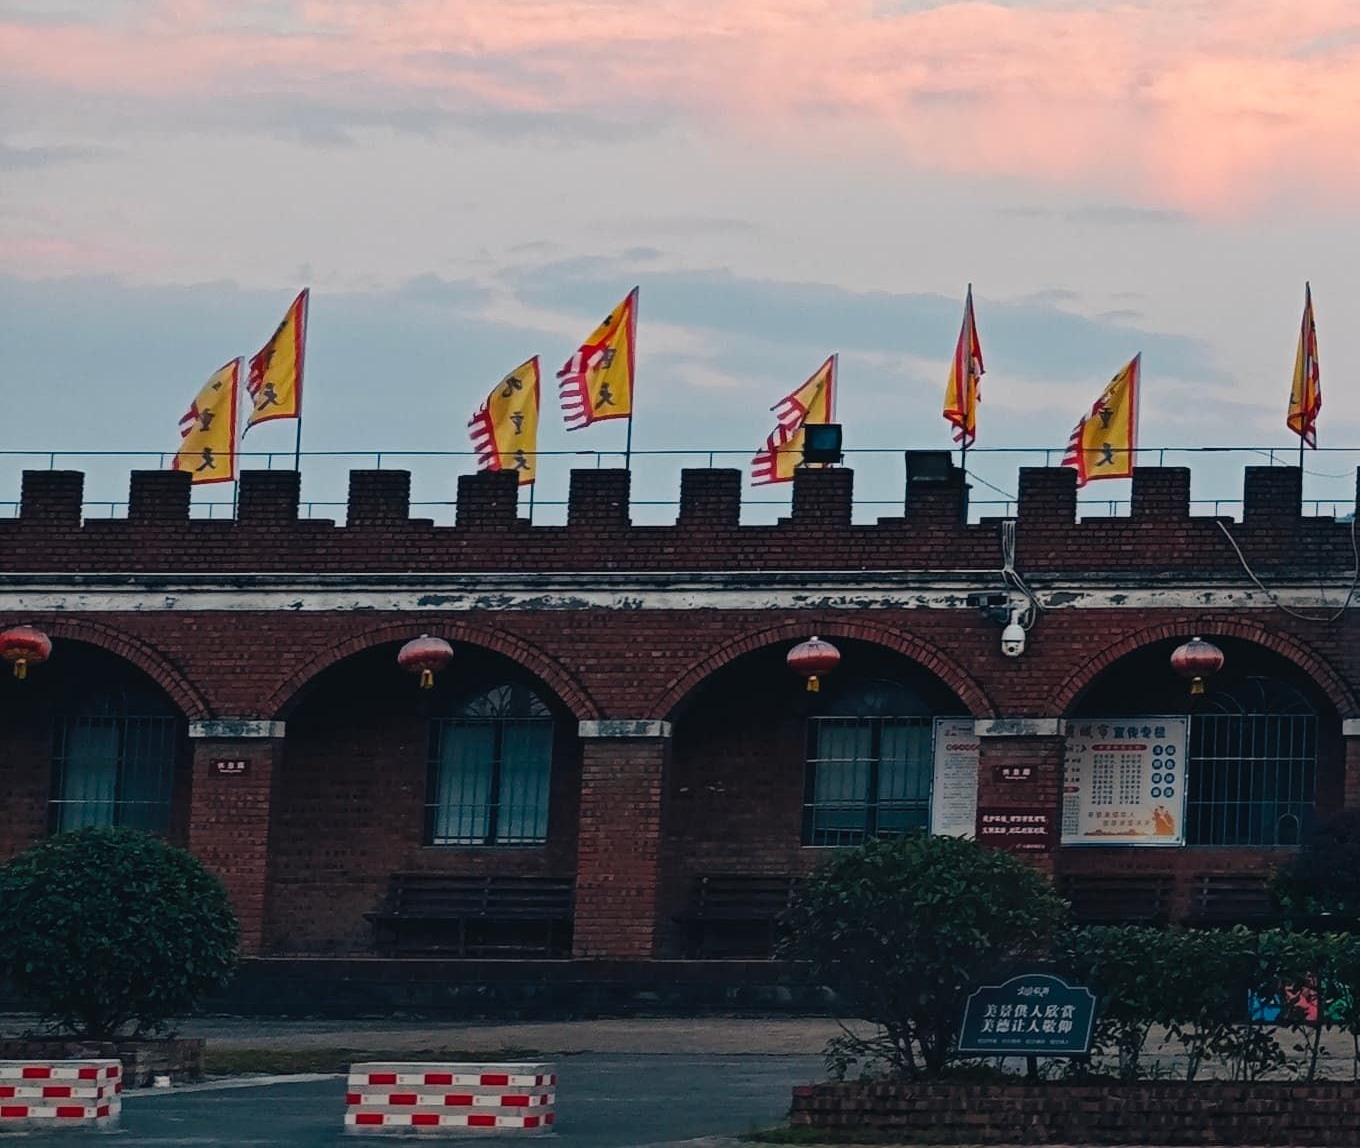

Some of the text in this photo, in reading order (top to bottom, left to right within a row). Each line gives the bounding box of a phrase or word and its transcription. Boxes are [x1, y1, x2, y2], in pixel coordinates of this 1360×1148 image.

[984, 1003, 1076, 1018] 美景供人欣赏
[980, 1018, 1073, 1033] 美德让人敬仰
